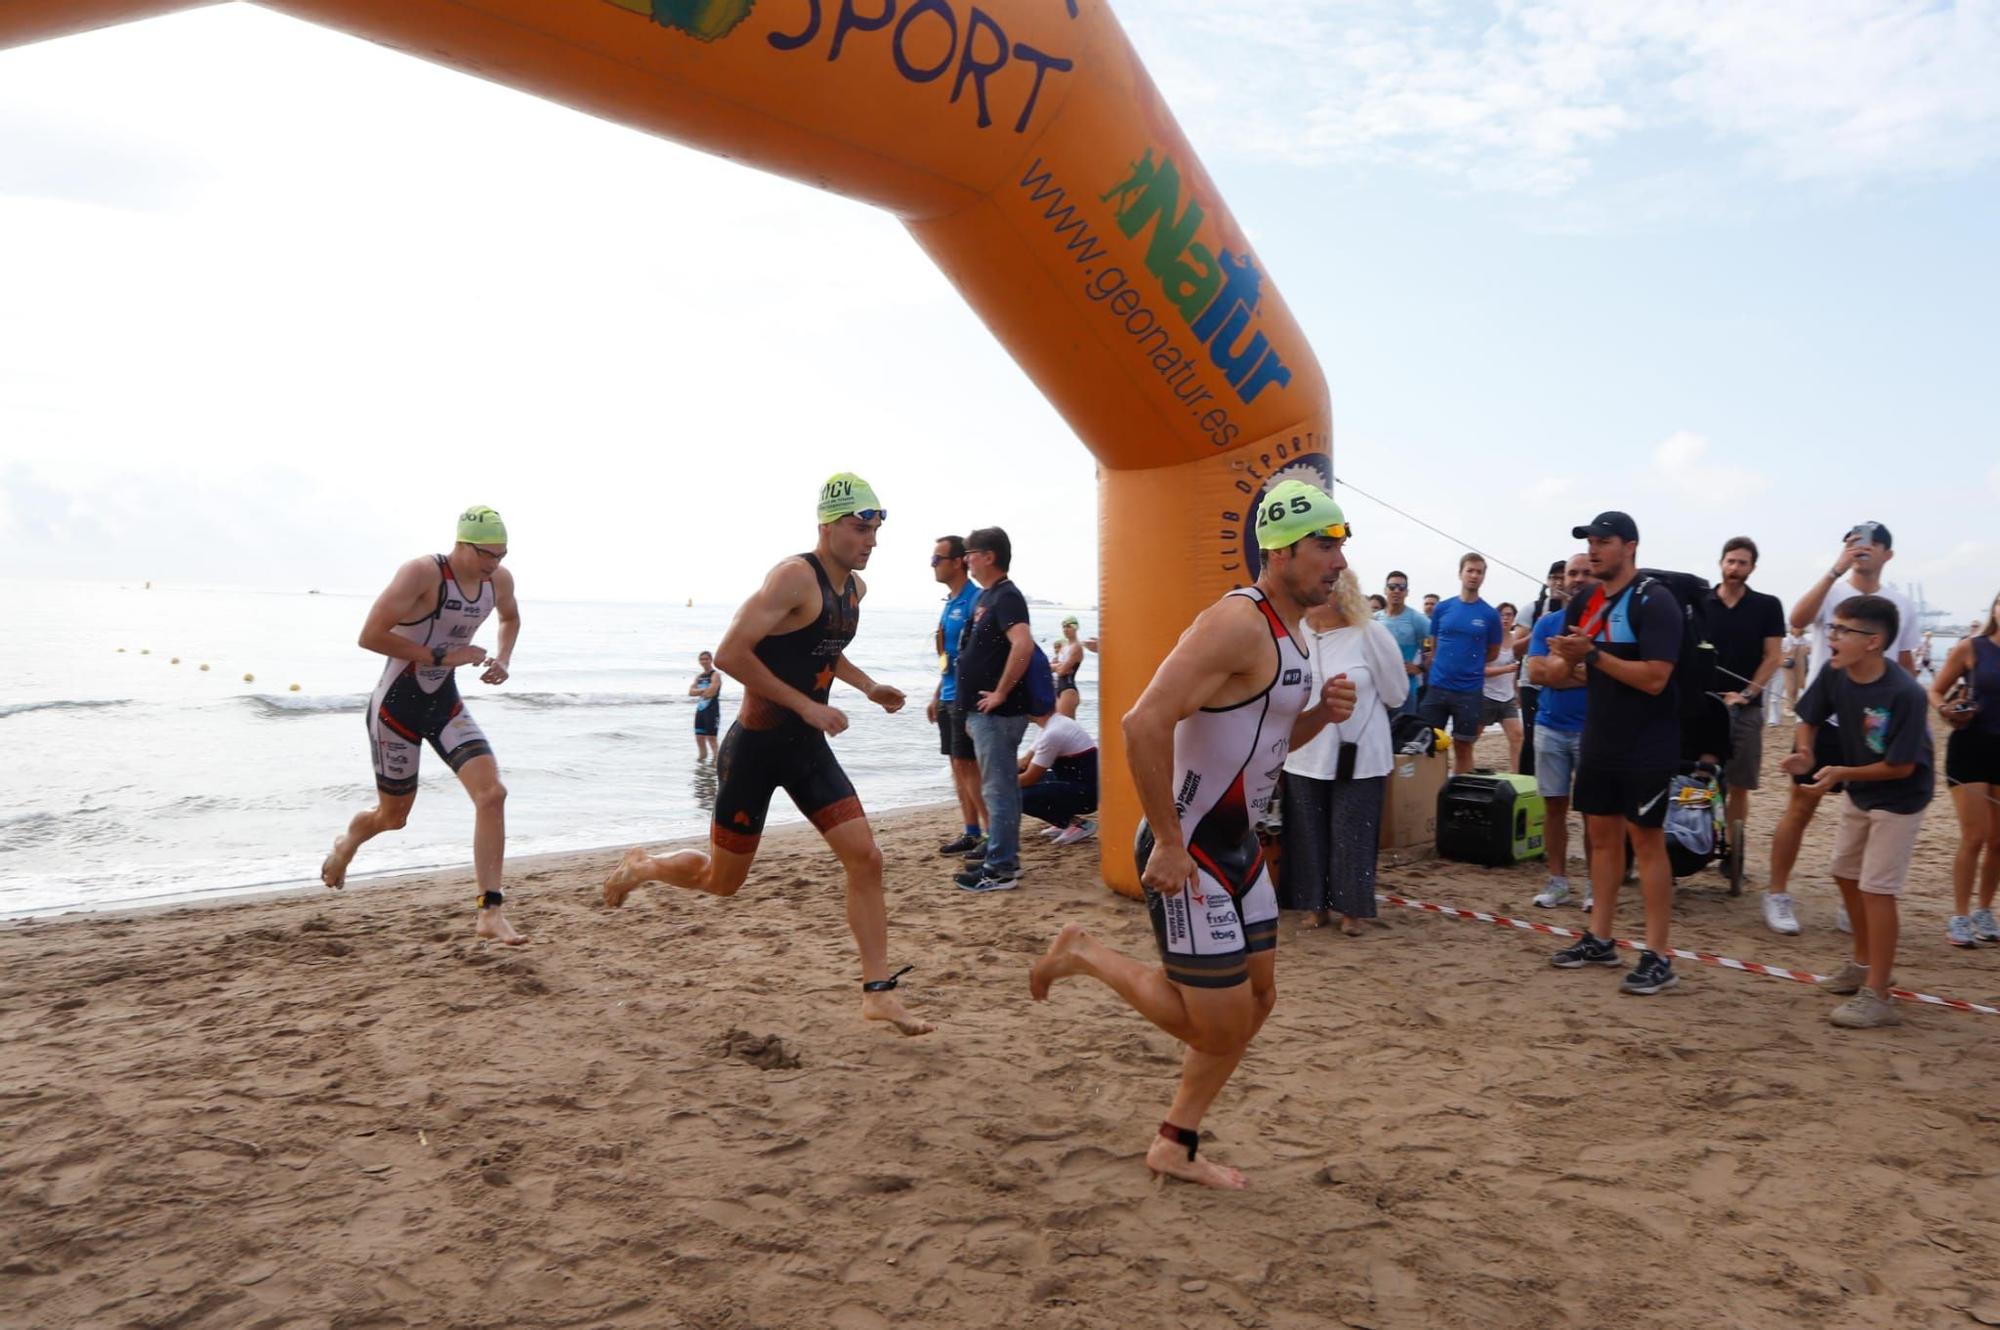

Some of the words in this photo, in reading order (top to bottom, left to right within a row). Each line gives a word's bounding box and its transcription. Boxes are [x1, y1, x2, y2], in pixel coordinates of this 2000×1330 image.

[767, 0, 1073, 133] SPORT
[1020, 158, 1239, 447] www.geonatur.es
[1113, 154, 1292, 405] Natur
[1221, 511, 1240, 571] CLUB
[1257, 496, 1312, 528] 265
